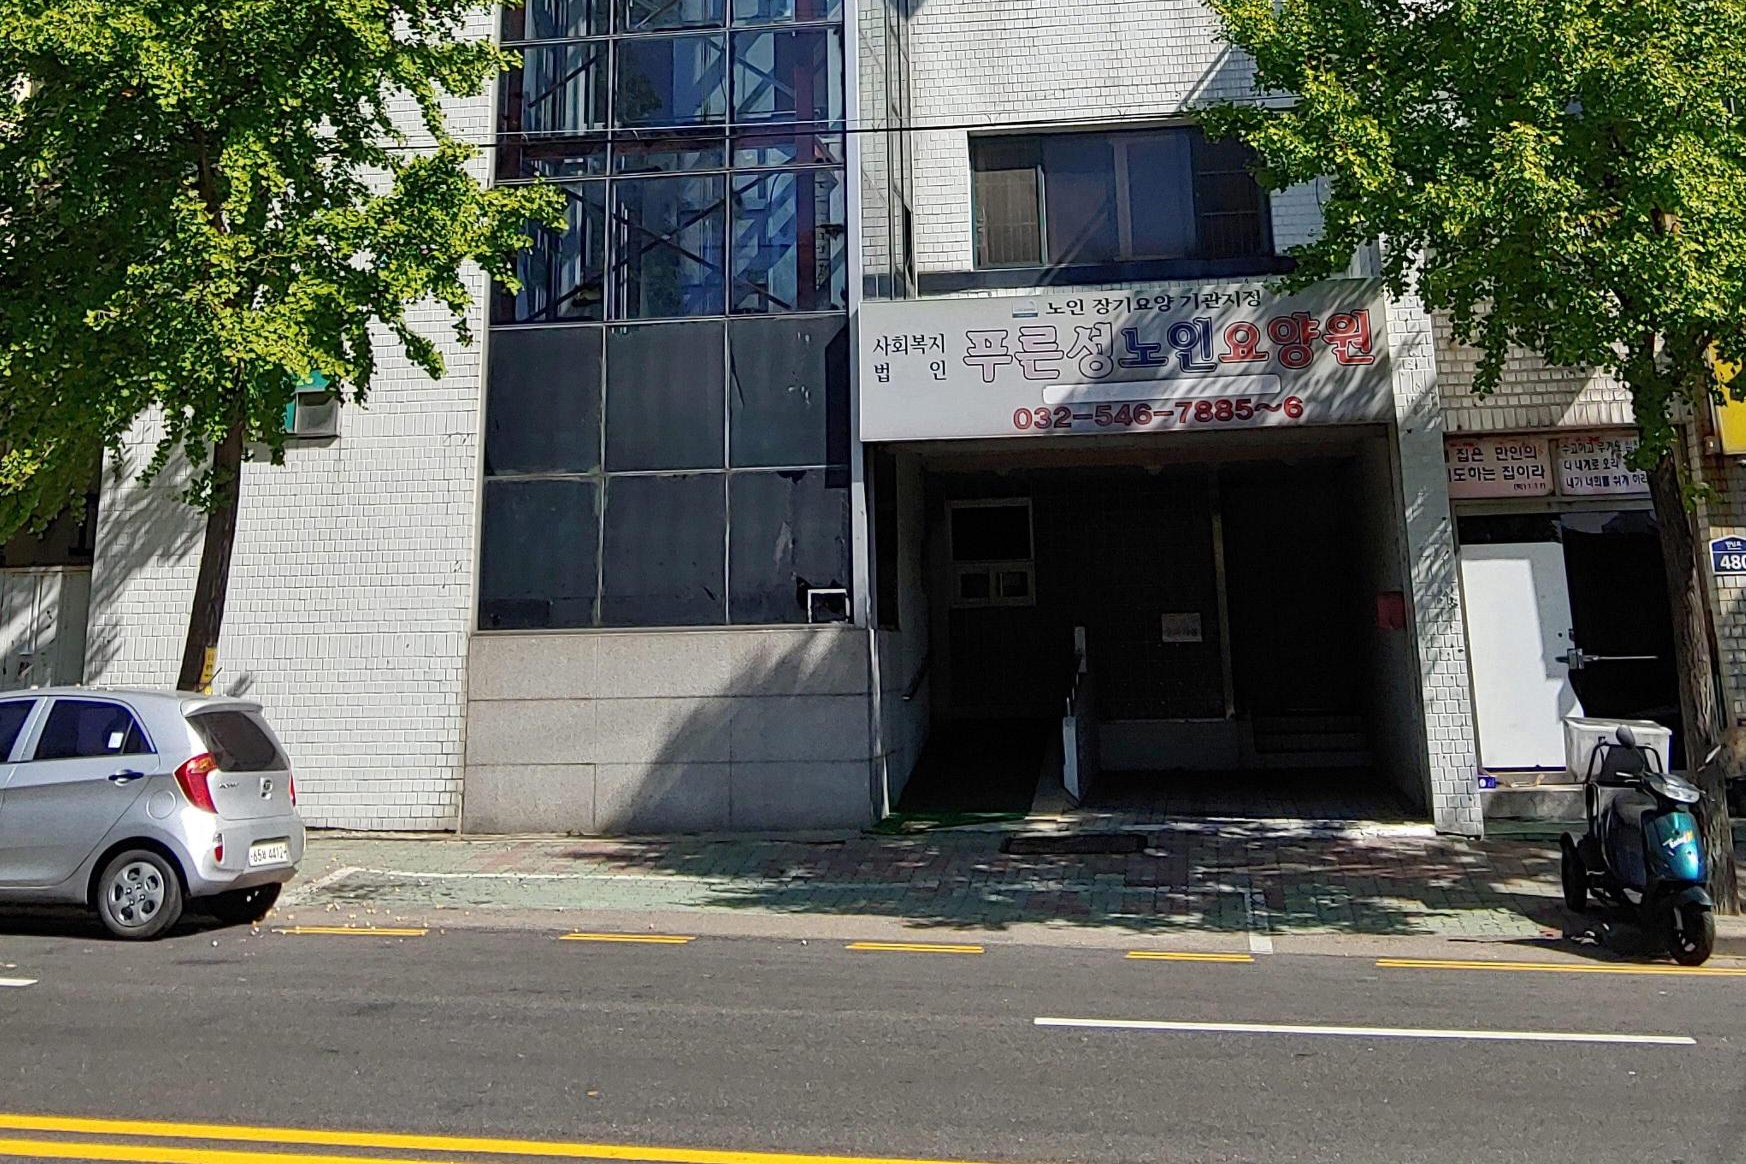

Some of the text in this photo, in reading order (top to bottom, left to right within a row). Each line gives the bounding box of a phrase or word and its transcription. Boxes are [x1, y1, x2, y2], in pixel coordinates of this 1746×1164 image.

[1046, 289, 1262, 317] 노인 장기요양 기관지정
[872, 333, 946, 357] 사회복지
[963, 308, 1376, 384] 푸른성노인요양원
[1013, 395, 1304, 431] 032-546-7885~6
[1456, 447, 1484, 463] 집은
[1494, 445, 1538, 461] 만인의
[1502, 465, 1545, 481] 집이라
